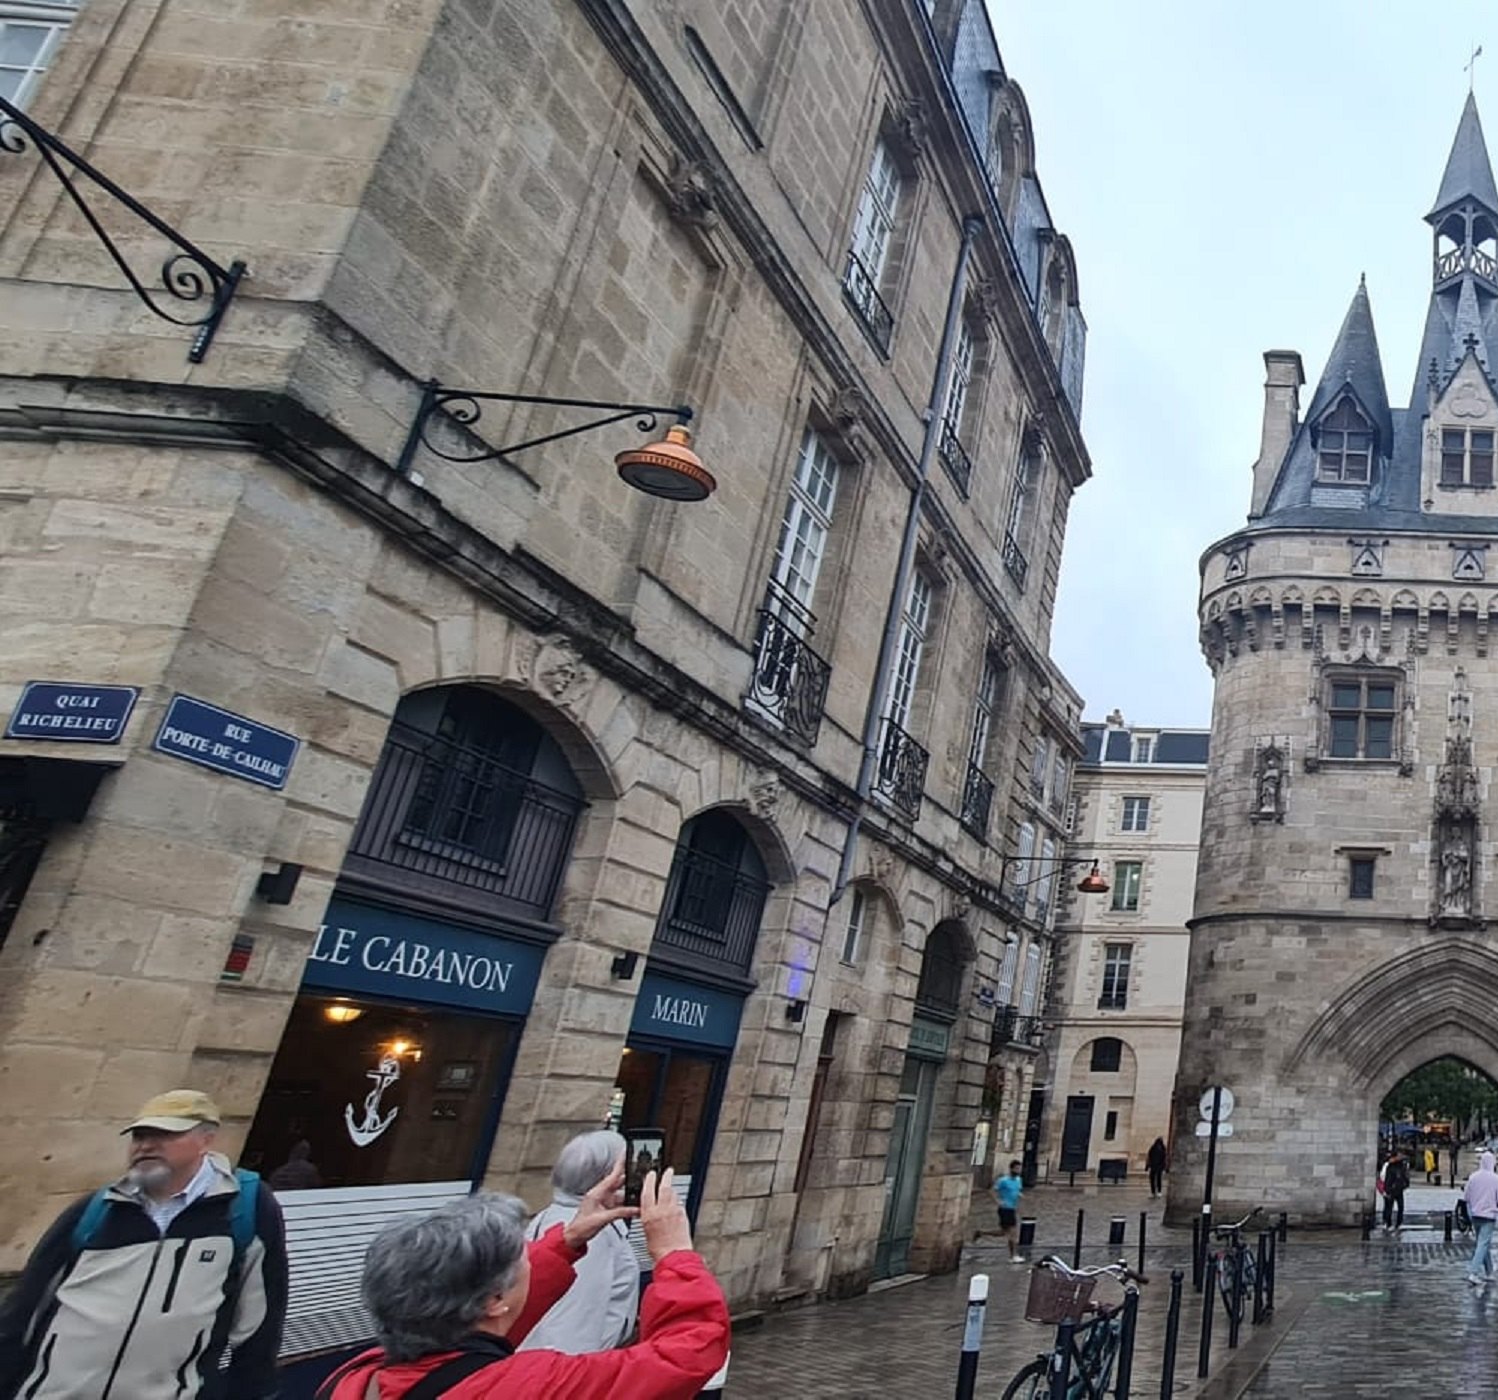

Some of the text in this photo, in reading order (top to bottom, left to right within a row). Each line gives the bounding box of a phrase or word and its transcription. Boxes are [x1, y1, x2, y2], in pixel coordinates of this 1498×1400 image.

[56, 695, 101, 709] QUAI
[18, 713, 118, 731] RICHELIEU
[224, 723, 253, 743] RUE
[162, 726, 288, 778] PORTE-DE-CAILHAU
[308, 924, 514, 993] LE CABANON
[651, 994, 709, 1028] MARIN
